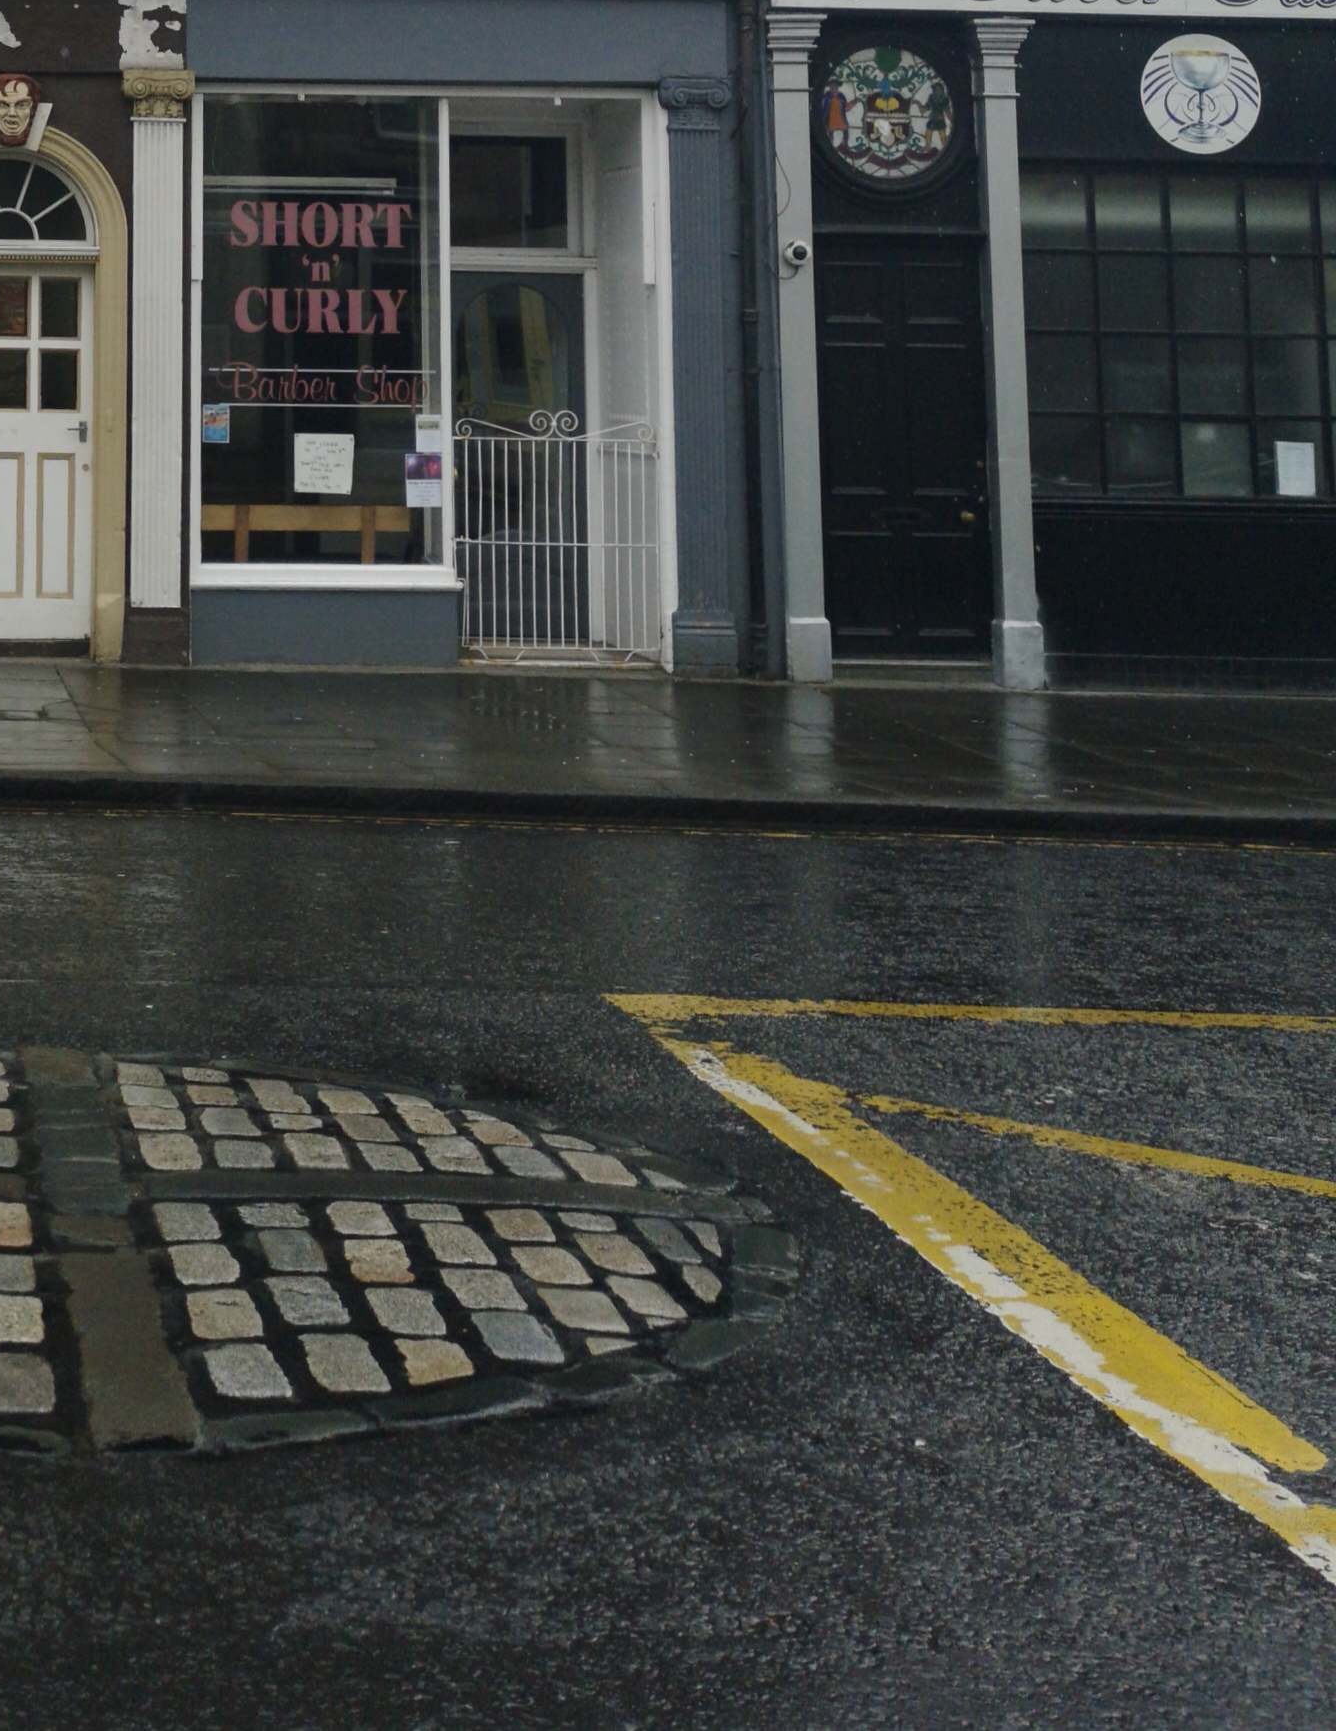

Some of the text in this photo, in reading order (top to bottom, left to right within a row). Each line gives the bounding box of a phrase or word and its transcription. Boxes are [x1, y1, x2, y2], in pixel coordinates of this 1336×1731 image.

[229, 200, 412, 248] SHORT
[234, 286, 408, 335] CURLY
[216, 361, 429, 414] Barber Shop
